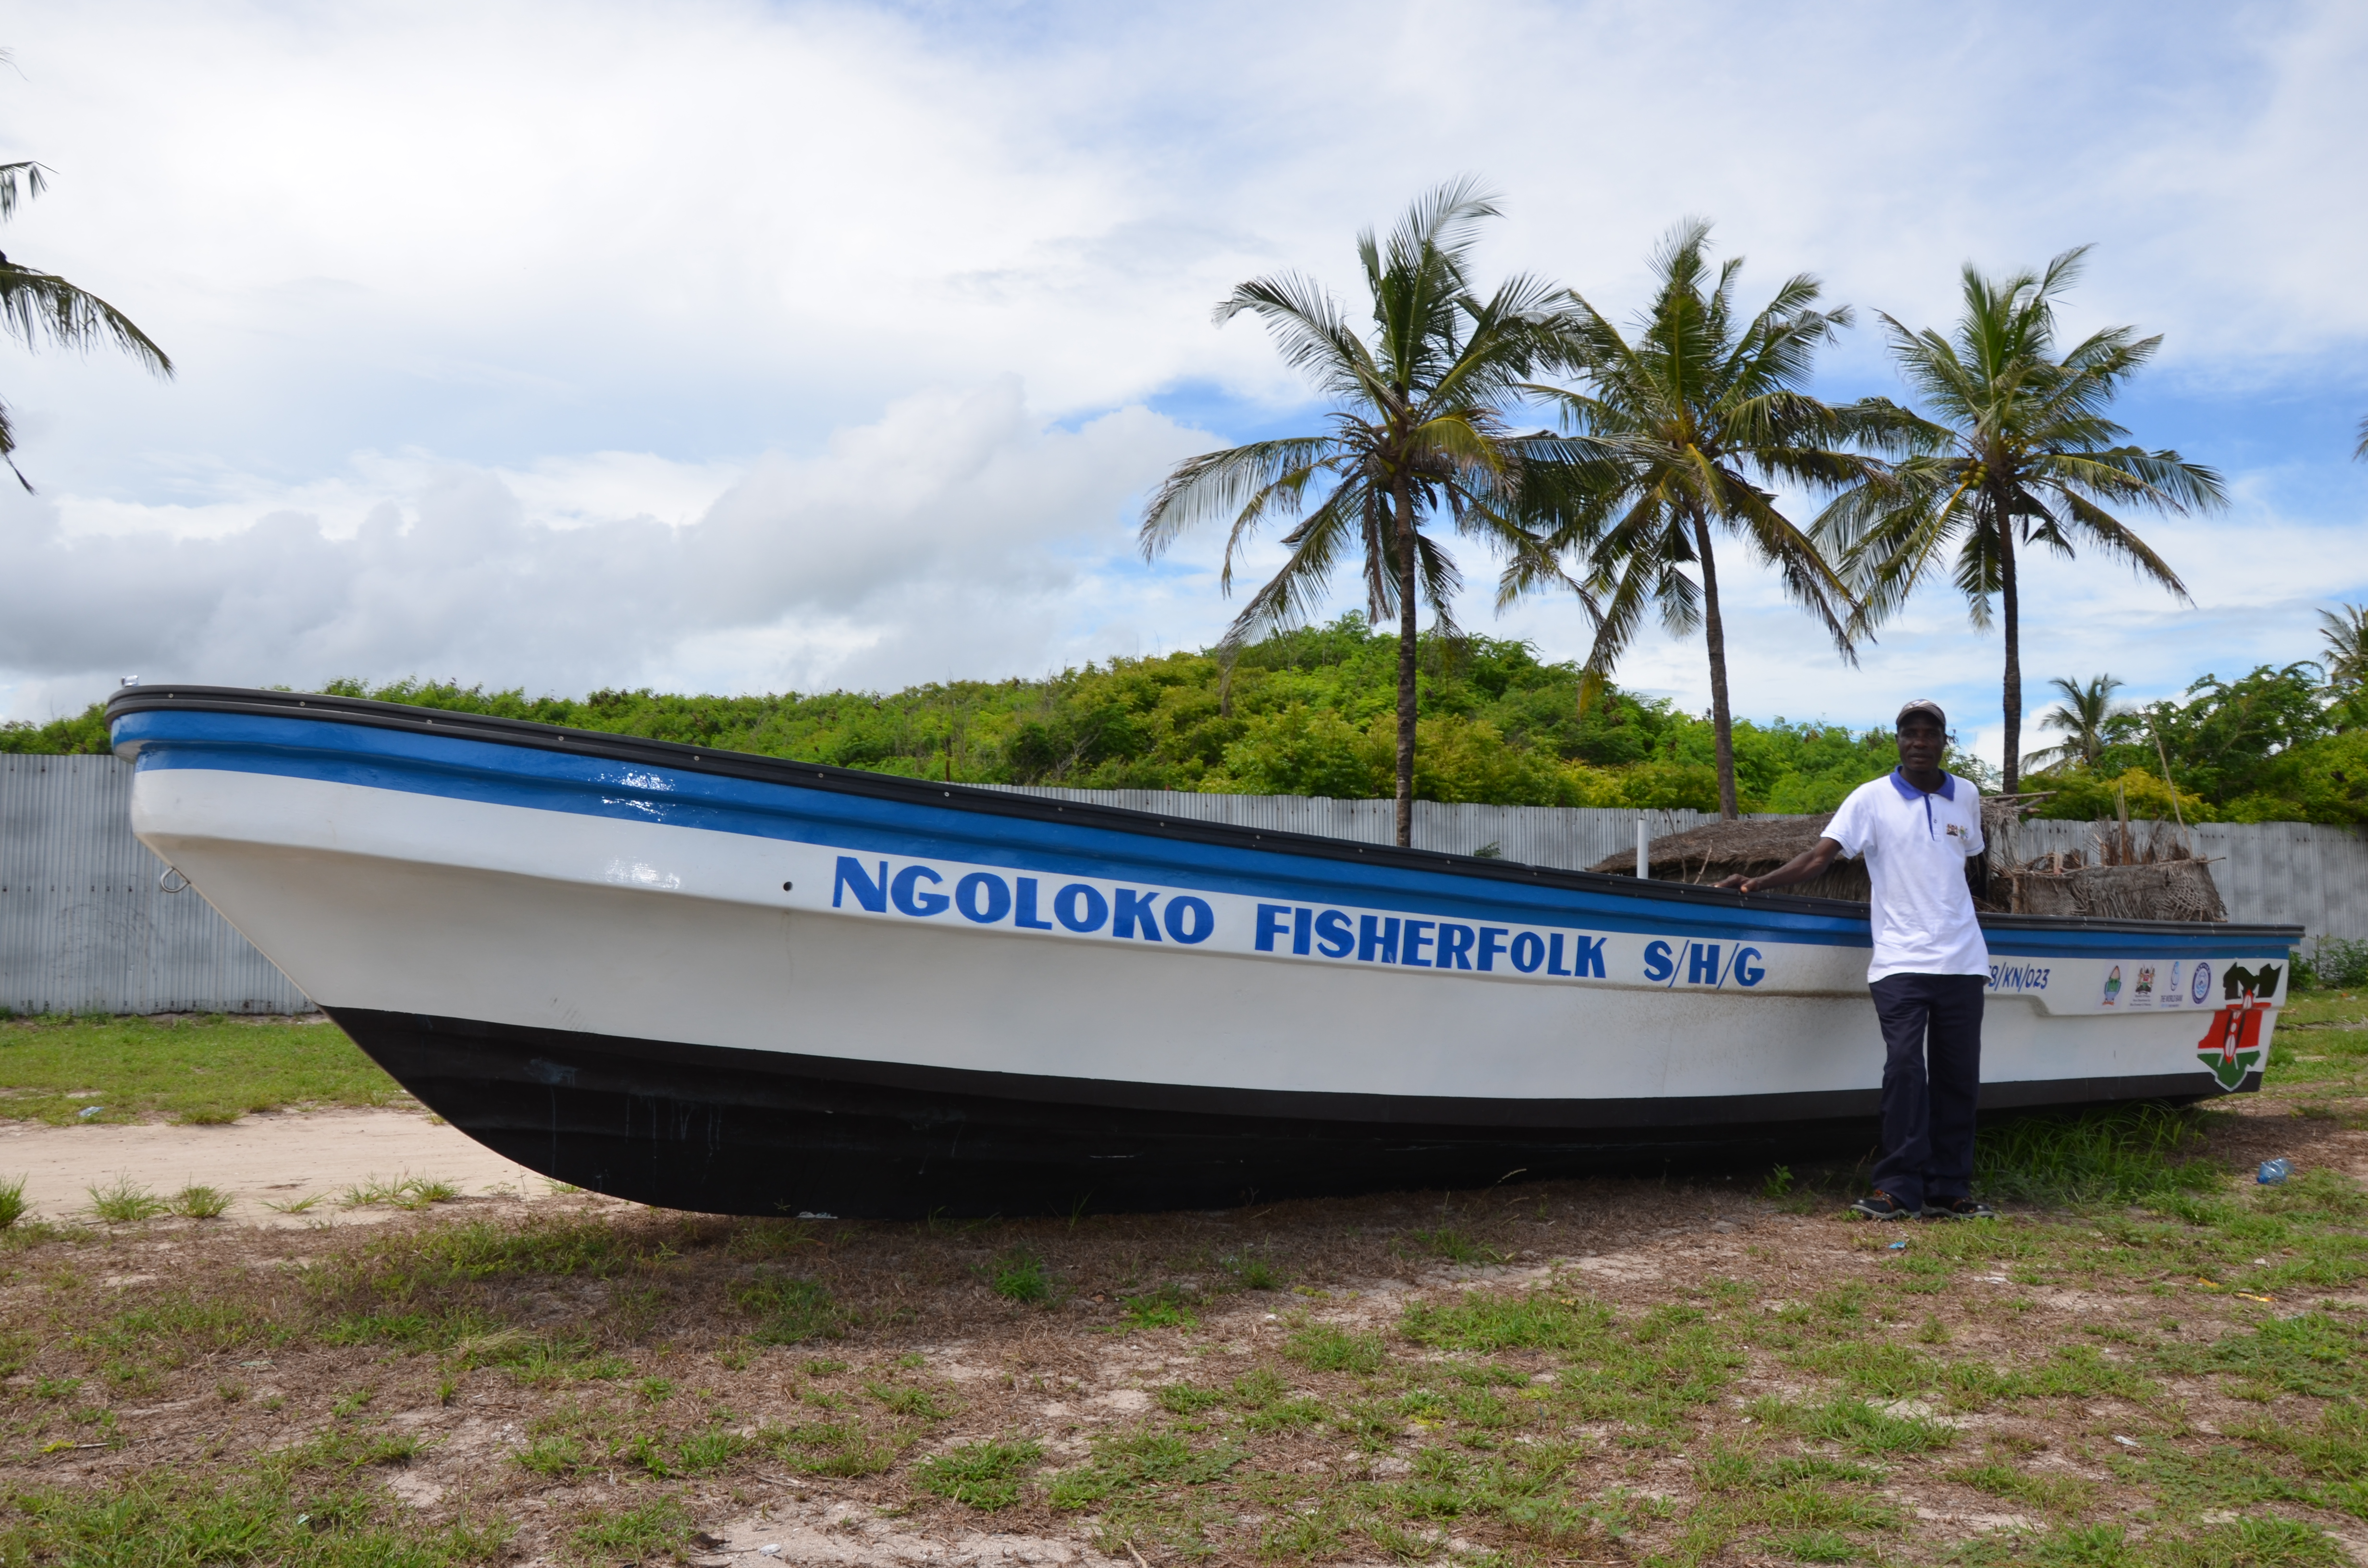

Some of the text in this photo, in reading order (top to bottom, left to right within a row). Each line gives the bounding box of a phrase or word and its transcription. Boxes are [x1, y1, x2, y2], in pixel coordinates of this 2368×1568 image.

[832, 856, 1766, 990] NGOLOKO FISHERFOLK S/H/G
